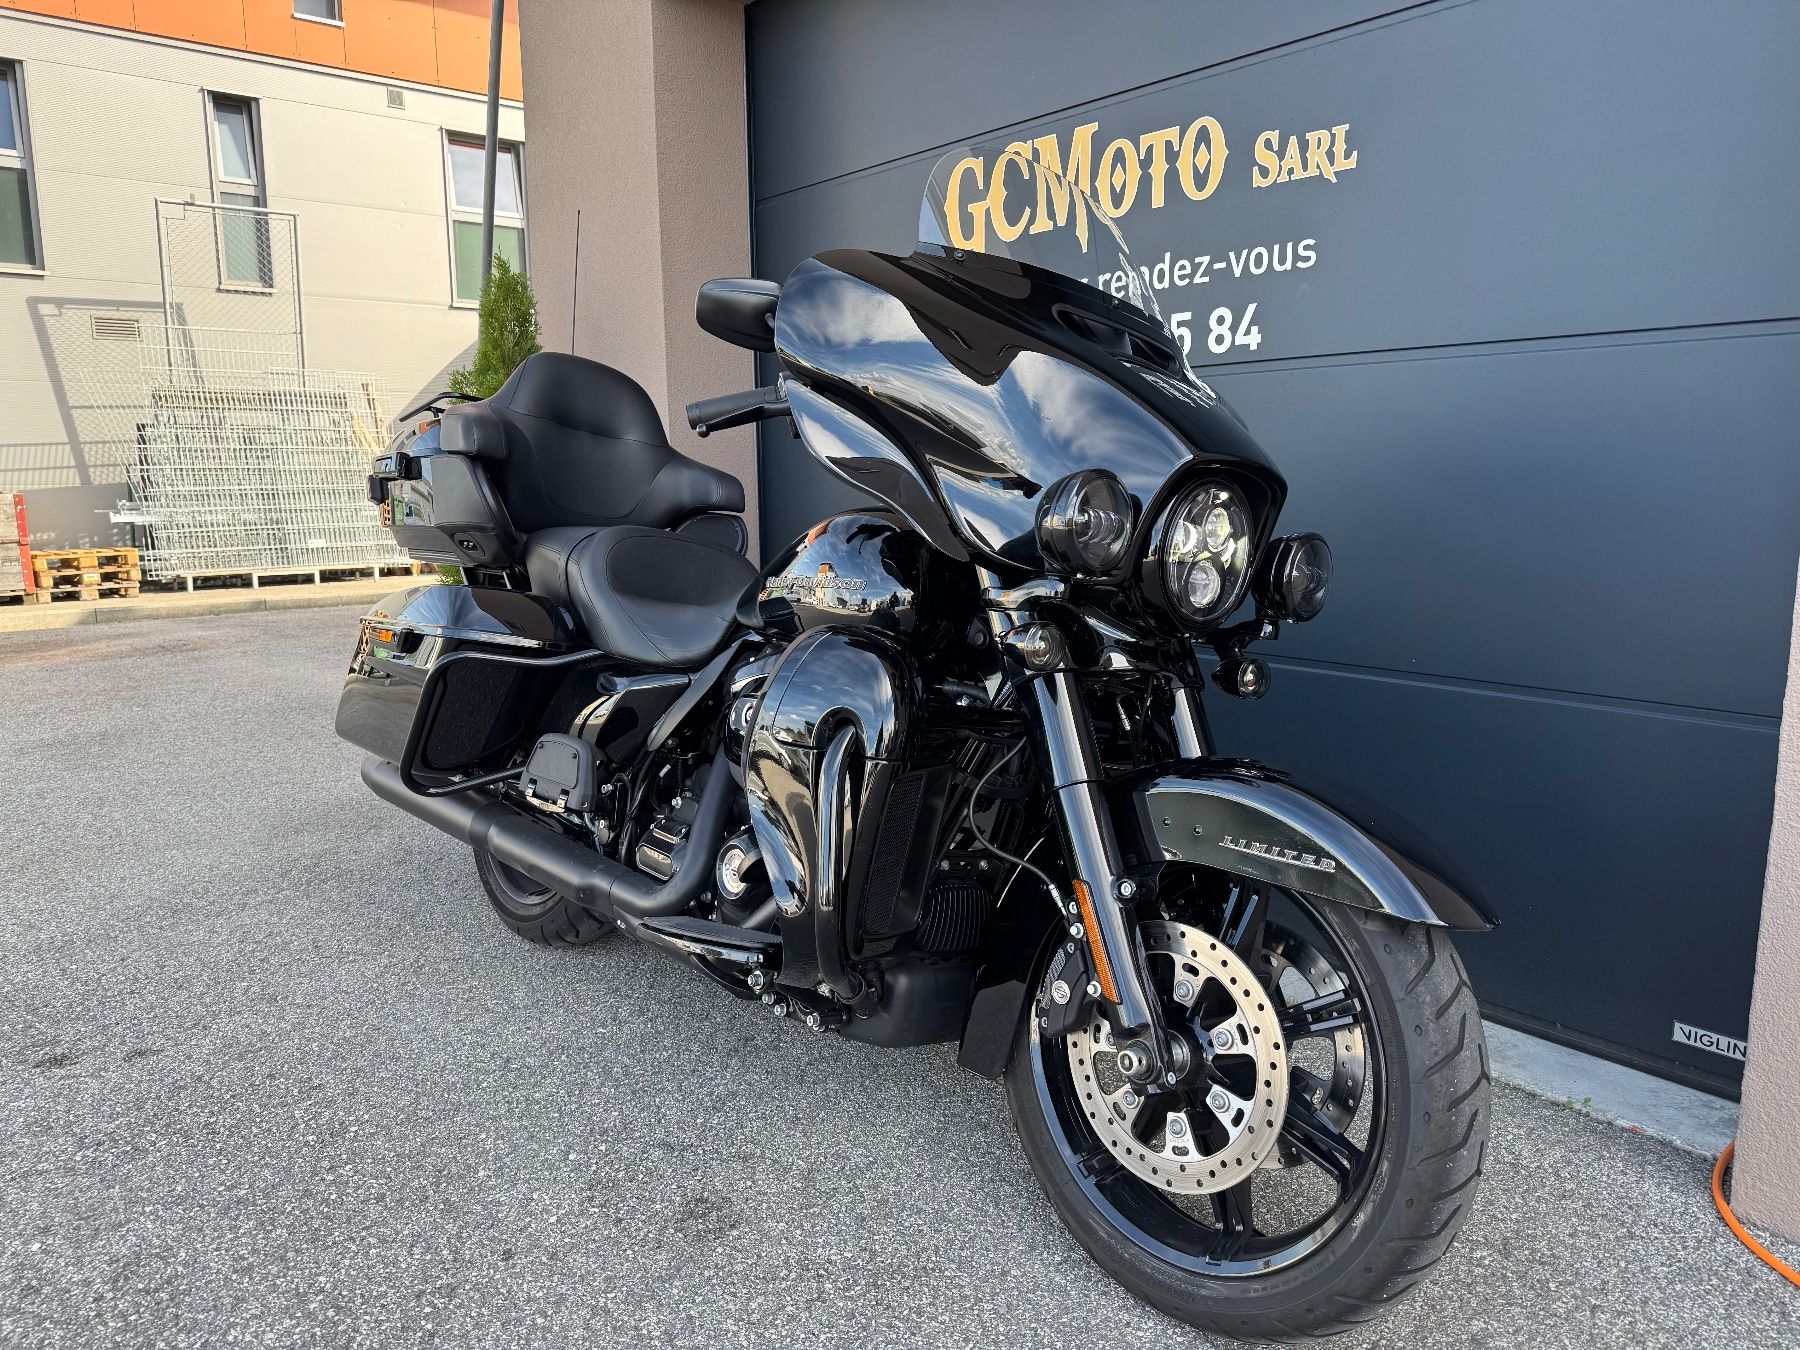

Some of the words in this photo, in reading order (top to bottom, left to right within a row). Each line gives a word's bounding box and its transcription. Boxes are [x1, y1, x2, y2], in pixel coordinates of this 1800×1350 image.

[1252, 123, 1358, 188] SARL
[1098, 238, 1317, 299] rendez-vous
[1207, 302, 1263, 354] 84
[1222, 835, 1336, 871] LIMITED
